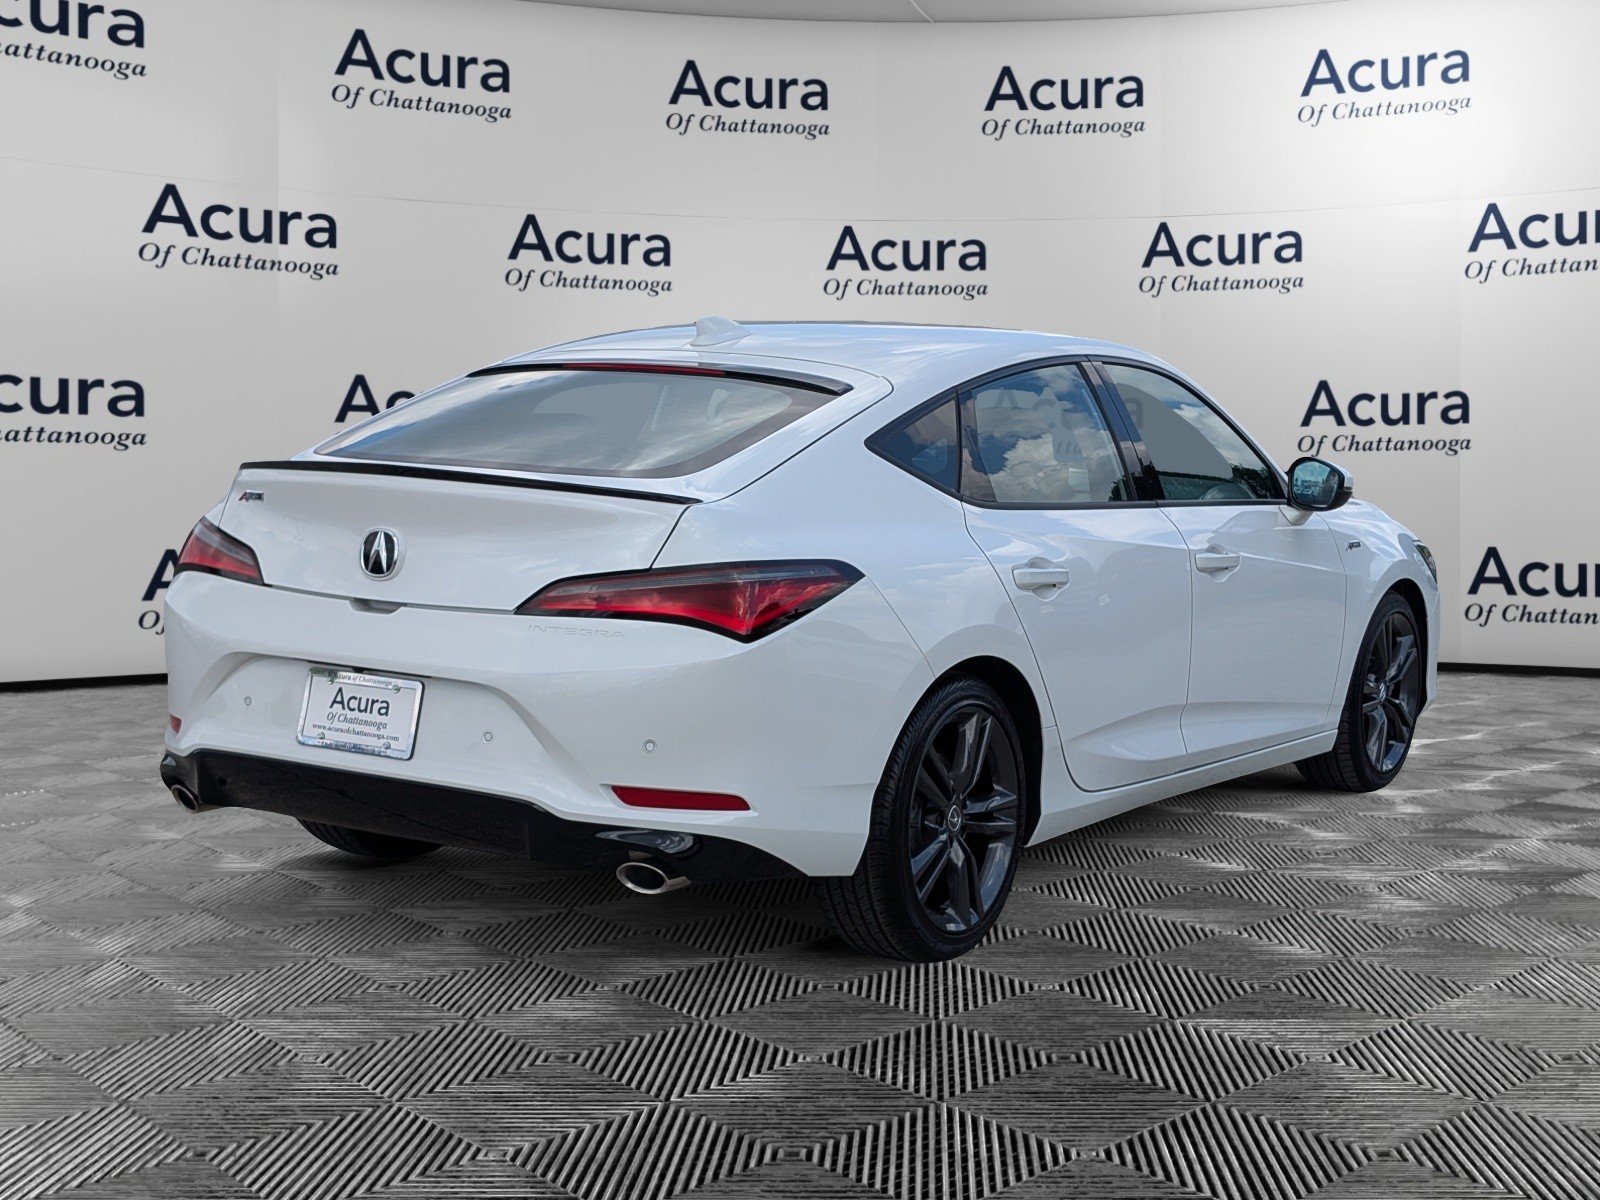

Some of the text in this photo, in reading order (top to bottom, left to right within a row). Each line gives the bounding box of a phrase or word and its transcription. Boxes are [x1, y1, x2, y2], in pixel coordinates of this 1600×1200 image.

[0, 41, 148, 80] attanooga
[335, 28, 511, 94] Acura
[1300, 48, 1470, 98] Acura
[668, 59, 829, 112] Acura
[984, 65, 1144, 112] Acura
[331, 84, 512, 123] Of Chattanooga
[1297, 96, 1472, 127] Of Chattanooga
[666, 111, 831, 141] Of Chattanooga
[981, 117, 1146, 141] Of Chattanooga
[142, 183, 338, 249] Acura
[1468, 202, 1600, 253] Acu
[508, 213, 672, 268] Acura
[826, 225, 987, 273] Acura
[1142, 221, 1303, 269] Acura
[138, 242, 340, 281] Of Chattanooga
[1464, 259, 1497, 285] Of
[504, 267, 673, 297] Of Chattanooga
[822, 277, 989, 301] Of Chattanooga
[1138, 273, 1305, 299] Of Chattanooga
[1300, 379, 1471, 428] Acura
[0, 425, 148, 452] attanooga
[1297, 433, 1472, 459] Of Chattanooga
[1467, 546, 1600, 598] Acu
[528, 624, 626, 639] INTEGRA
[1464, 603, 1497, 628] Of
[329, 686, 391, 717] Acura
[312, 722, 400, 742] www.acuraofchattanooga.com
[326, 711, 388, 731] Of Chattanooga
